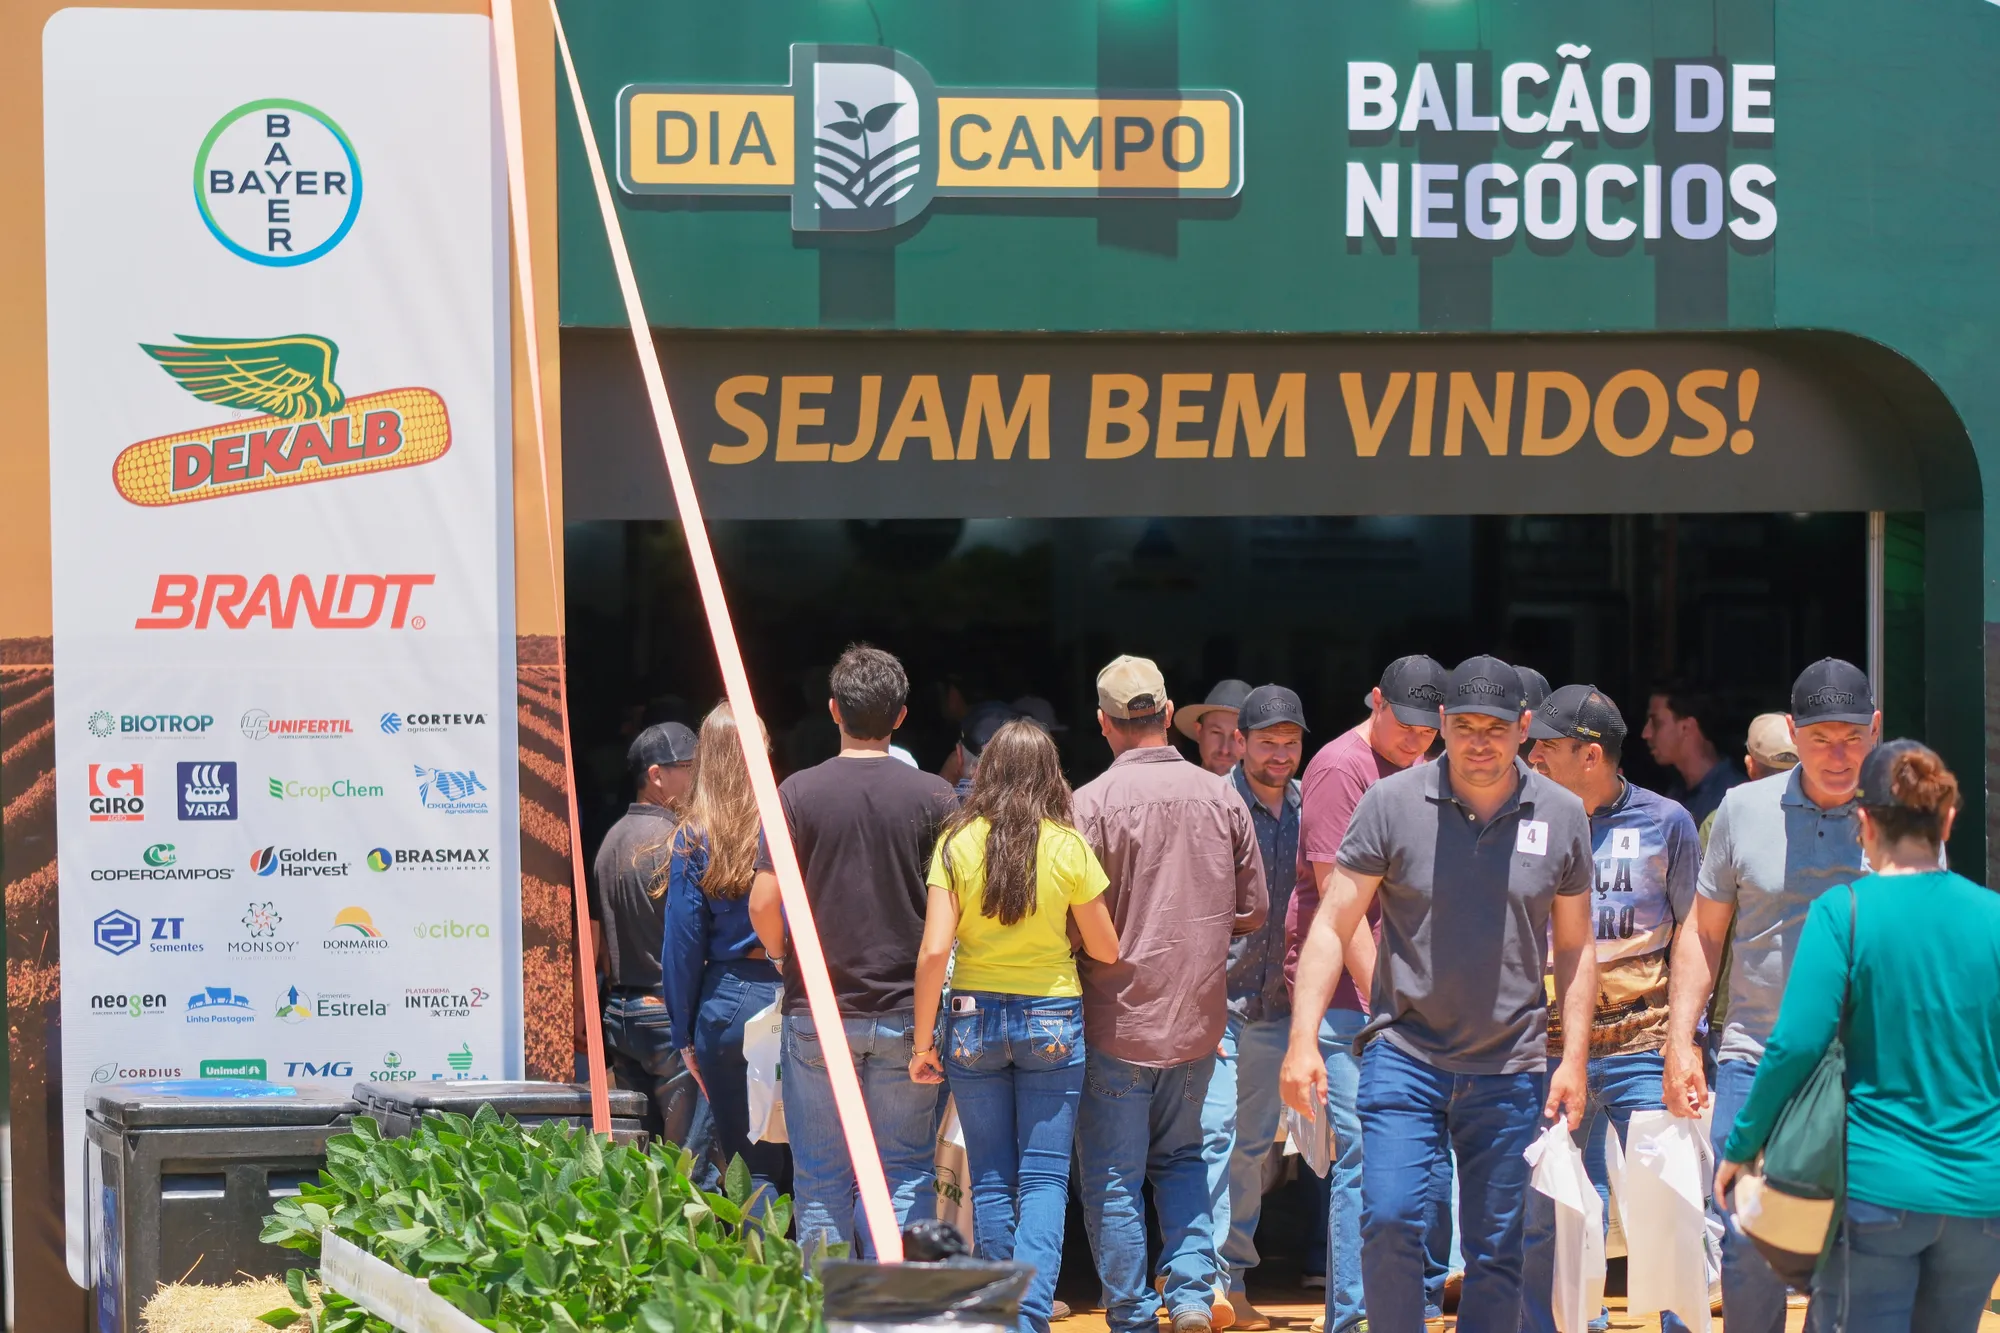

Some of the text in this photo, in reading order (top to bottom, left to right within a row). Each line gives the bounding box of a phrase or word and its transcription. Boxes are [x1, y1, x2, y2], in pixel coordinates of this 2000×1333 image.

[1346, 43, 1776, 134] BALCÃO DE
[655, 109, 777, 166] DIA
[949, 113, 1205, 173] CAMPO
[209, 170, 347, 195] BAYER
[264, 113, 293, 252] BAYER
[1345, 141, 1778, 241] NEGÓCIOS
[708, 368, 1761, 465] SEJAM BEM VINDOS!
[172, 409, 403, 492] DEKALB
[134, 573, 436, 630] BRANDT
[1458, 682, 1506, 698] PLANTAR
[120, 715, 214, 732] BIOTROP
[268, 719, 354, 733] UNIFERTIL
[406, 713, 486, 725] CORTEVA
[285, 779, 384, 802] CropChem
[89, 797, 144, 814] GIRO
[185, 803, 231, 816] YARA
[1527, 828, 1536, 844] 4
[1620, 836, 1630, 850] 4
[279, 848, 337, 862] Golden
[395, 848, 490, 863] BRASMAX
[90, 868, 232, 881] COPERCAMPOS
[281, 862, 349, 877] Harvest
[1594, 857, 1633, 901] ÇA
[151, 917, 185, 940] ZT
[429, 920, 490, 939] cibra
[1596, 904, 1635, 940] RO
[150, 943, 204, 952] Sementes
[228, 941, 295, 953] MONSOY
[323, 939, 388, 949] DONMARIO
[91, 994, 167, 1018] neogen
[317, 999, 387, 1017] Estrela
[405, 995, 468, 1008] INTACTA
[186, 1015, 255, 1024] Linha Pastagem
[119, 1068, 181, 1078] CORDIUS
[206, 1066, 246, 1076] Unimed
[284, 1061, 354, 1078] TMG
[369, 1069, 417, 1082] SOESP
